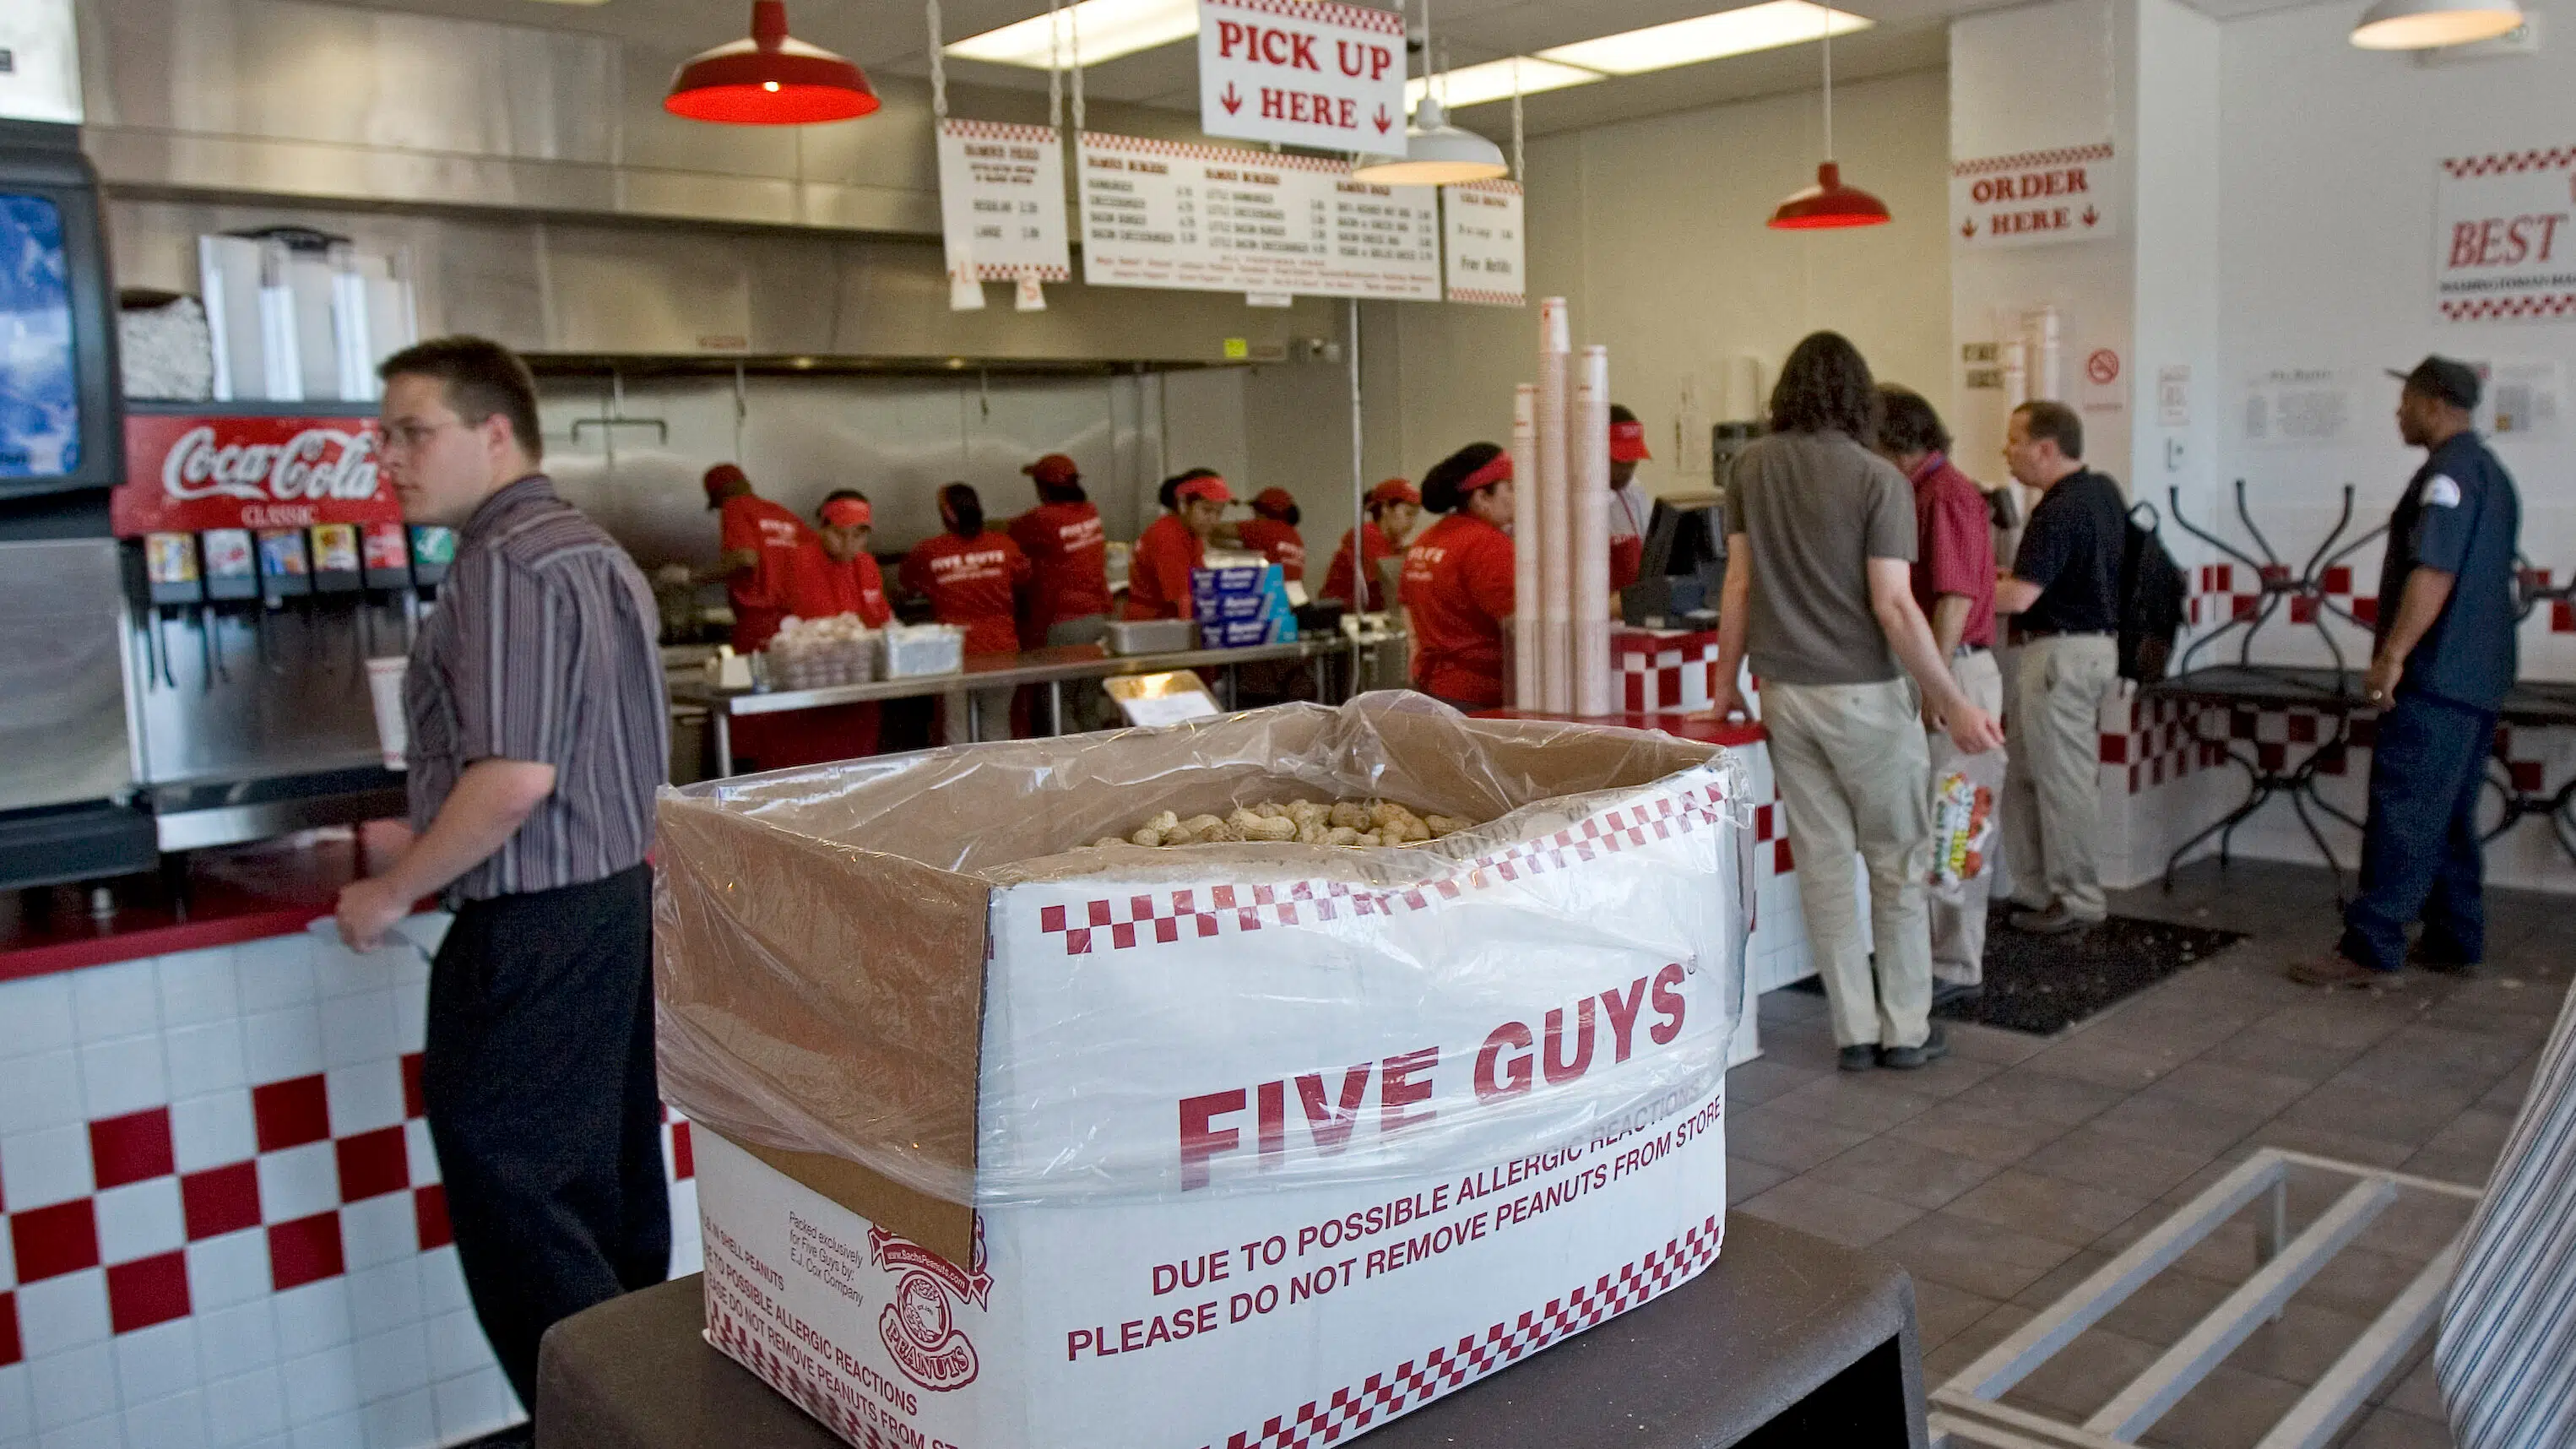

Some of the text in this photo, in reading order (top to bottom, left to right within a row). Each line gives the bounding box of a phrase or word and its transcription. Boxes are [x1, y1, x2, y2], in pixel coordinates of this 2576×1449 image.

[1217, 20, 1392, 80] PICK UP
[1261, 88, 1359, 128] HERE
[1971, 167, 2089, 204] ORDER
[1991, 208, 2071, 236] HERE
[2448, 213, 2569, 270] BEST
[162, 426, 379, 501] Coca-Cola
[241, 504, 316, 528] CLASSIC
[1179, 963, 1686, 1192] FIVE GUYS
[789, 1211, 863, 1268] Packed exclusively
[1067, 1094, 1721, 1361] PLEASE DO NOT REMOVE PEANUTS FROM STORE
[1152, 1250, 1229, 1296] DUE
[1241, 1235, 1287, 1272] TO
[1298, 1184, 1450, 1256] POSSIBLE
[1456, 1136, 1582, 1206] ALLERGIC
[745, 1250, 784, 1292] PEANUTS
[790, 1229, 800, 1245] for
[801, 1237, 817, 1256] Five
[819, 1248, 839, 1272] Guys
[806, 1258, 822, 1279] Cox
[824, 1269, 864, 1308] Company
[726, 1263, 773, 1317] POSSIBLE
[775, 1305, 832, 1360] ALLERGIC
[835, 1347, 918, 1416] REACTIONS
[886, 1318, 970, 1381] PEANUTS
[729, 1293, 743, 1318] DO
[745, 1306, 765, 1337] NOT
[767, 1326, 816, 1378] REMOVE
[817, 1364, 878, 1423] PEANUTS
[880, 1408, 925, 1449] FROM
